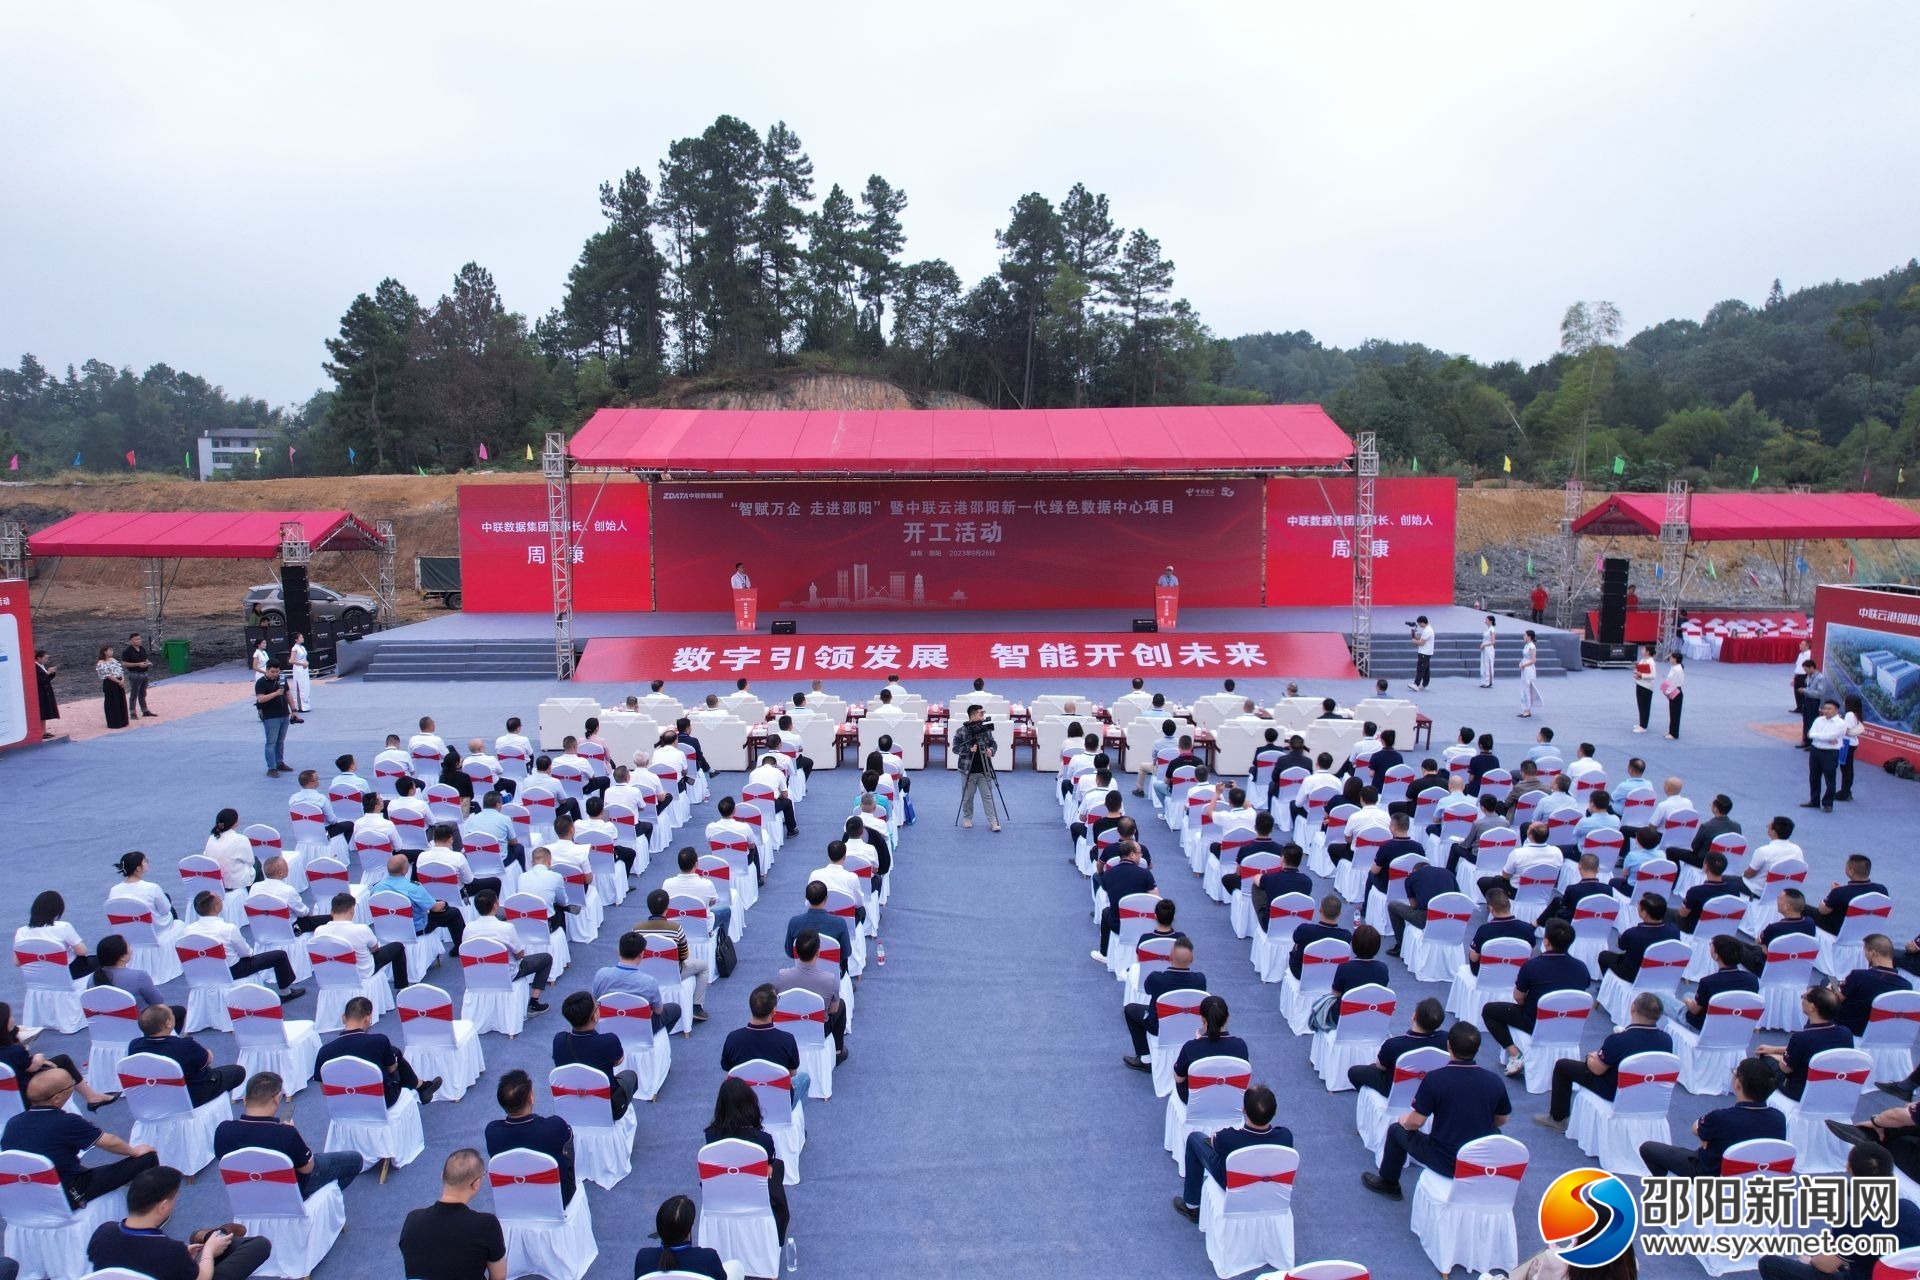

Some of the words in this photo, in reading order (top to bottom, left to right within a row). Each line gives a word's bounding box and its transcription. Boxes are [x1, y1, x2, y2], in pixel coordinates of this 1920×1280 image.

[890, 500, 1174, 515] 暨中联云港邵阳新一代绿色数据中心项目
[903, 521, 1002, 544] 开工活动
[527, 546, 546, 564] 周
[1331, 539, 1350, 558] 周
[1371, 538, 1390, 558] 康
[1858, 607, 1920, 627] 中联云港邵阳
[671, 644, 950, 674] 数字引领发展
[990, 641, 1268, 669] 智能开创未来
